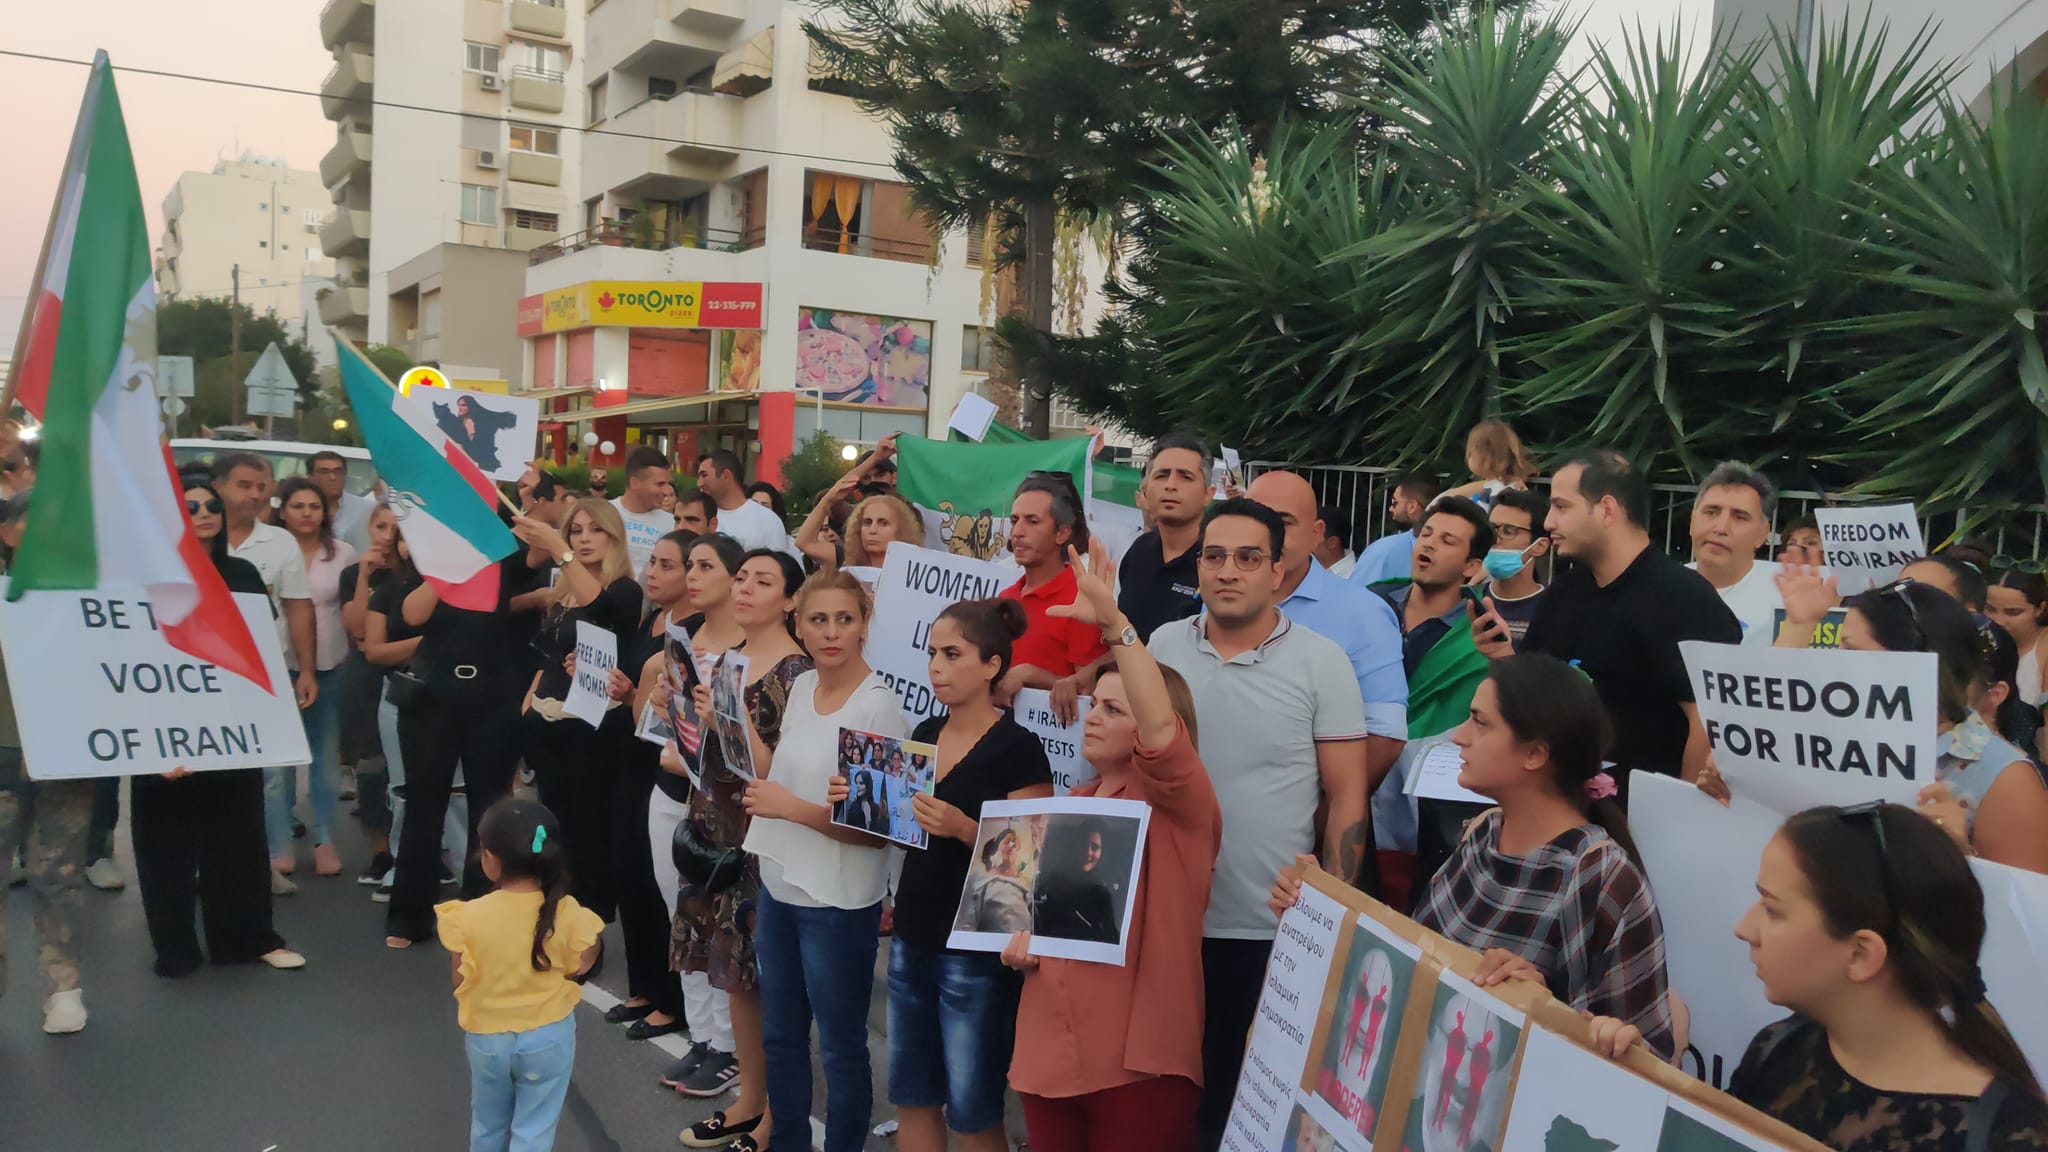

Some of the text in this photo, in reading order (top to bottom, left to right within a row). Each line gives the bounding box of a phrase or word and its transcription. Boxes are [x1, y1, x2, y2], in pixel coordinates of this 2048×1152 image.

[617, 290, 694, 312] TORONTO
[1823, 522, 1911, 542] FREEDOM
[1827, 550, 1921, 570] FOR IRAN
[80, 598, 130, 630] BE
[912, 620, 931, 651] LI
[577, 641, 615, 671] FREE IRAN
[100, 663, 222, 694] VOICE
[578, 670, 609, 700] WOMEN
[1702, 669, 1913, 722] FREEDOM
[88, 723, 263, 761] OF IRAN!
[1706, 719, 1916, 780] FOR IRAN
[1295, 896, 1323, 924] έλουμε
